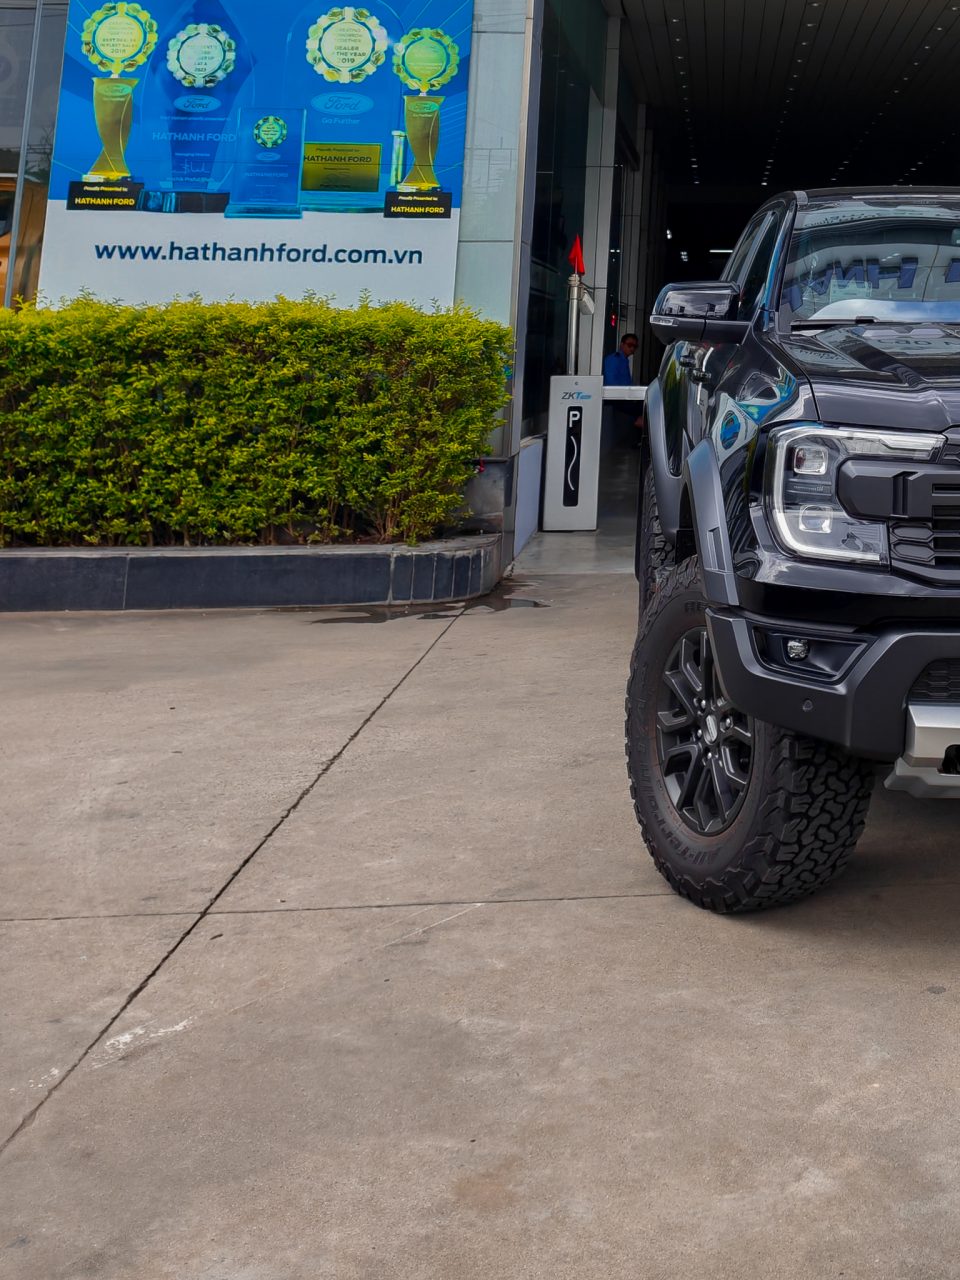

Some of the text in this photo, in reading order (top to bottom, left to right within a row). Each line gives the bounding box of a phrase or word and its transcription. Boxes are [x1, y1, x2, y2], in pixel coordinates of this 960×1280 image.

[75, 196, 135, 206] HATHANH FORD
[391, 206, 445, 214] HATHANH FORD
[95, 242, 424, 266] www.hathanhford.com.vn
[569, 410, 580, 428] P
